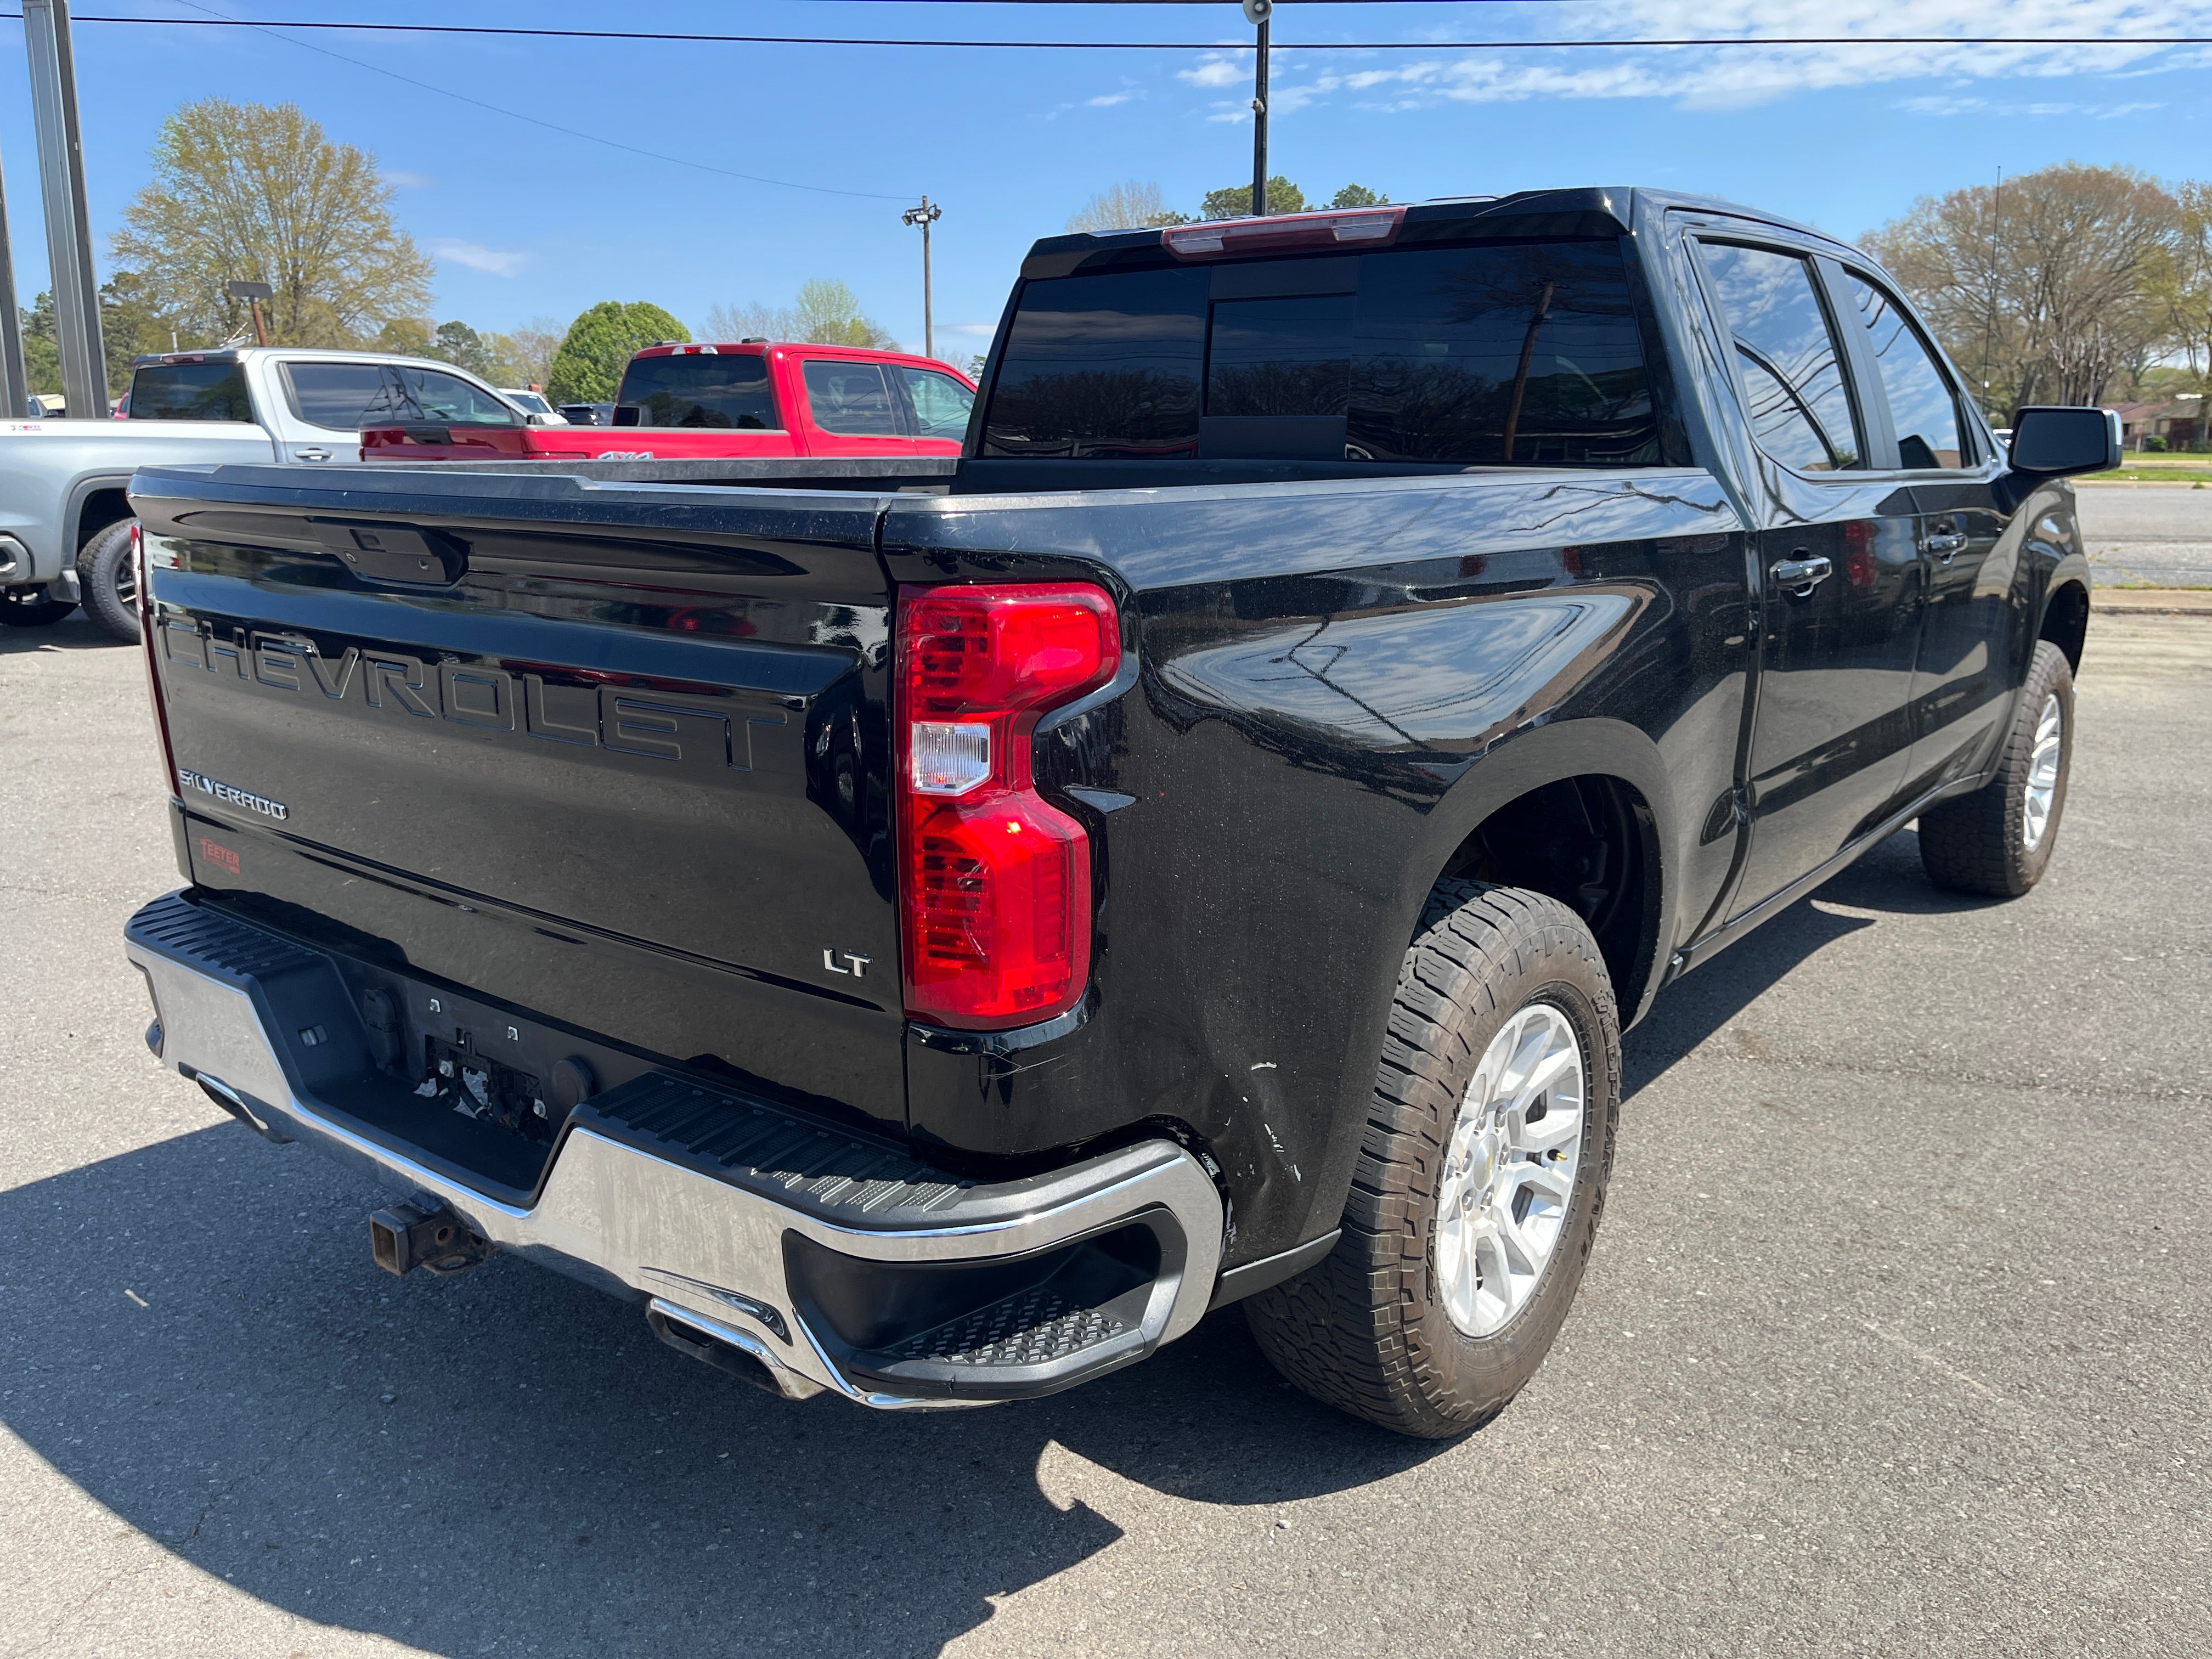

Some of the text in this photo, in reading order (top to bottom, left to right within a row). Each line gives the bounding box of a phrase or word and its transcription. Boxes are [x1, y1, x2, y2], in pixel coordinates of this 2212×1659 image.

[162, 612, 788, 772] CHEVROLET
[179, 769, 288, 820] SILVERADO
[200, 838, 240, 867] TEETER
[823, 948, 873, 977] LT
[1592, 988, 1618, 1180] WILDPEAK
